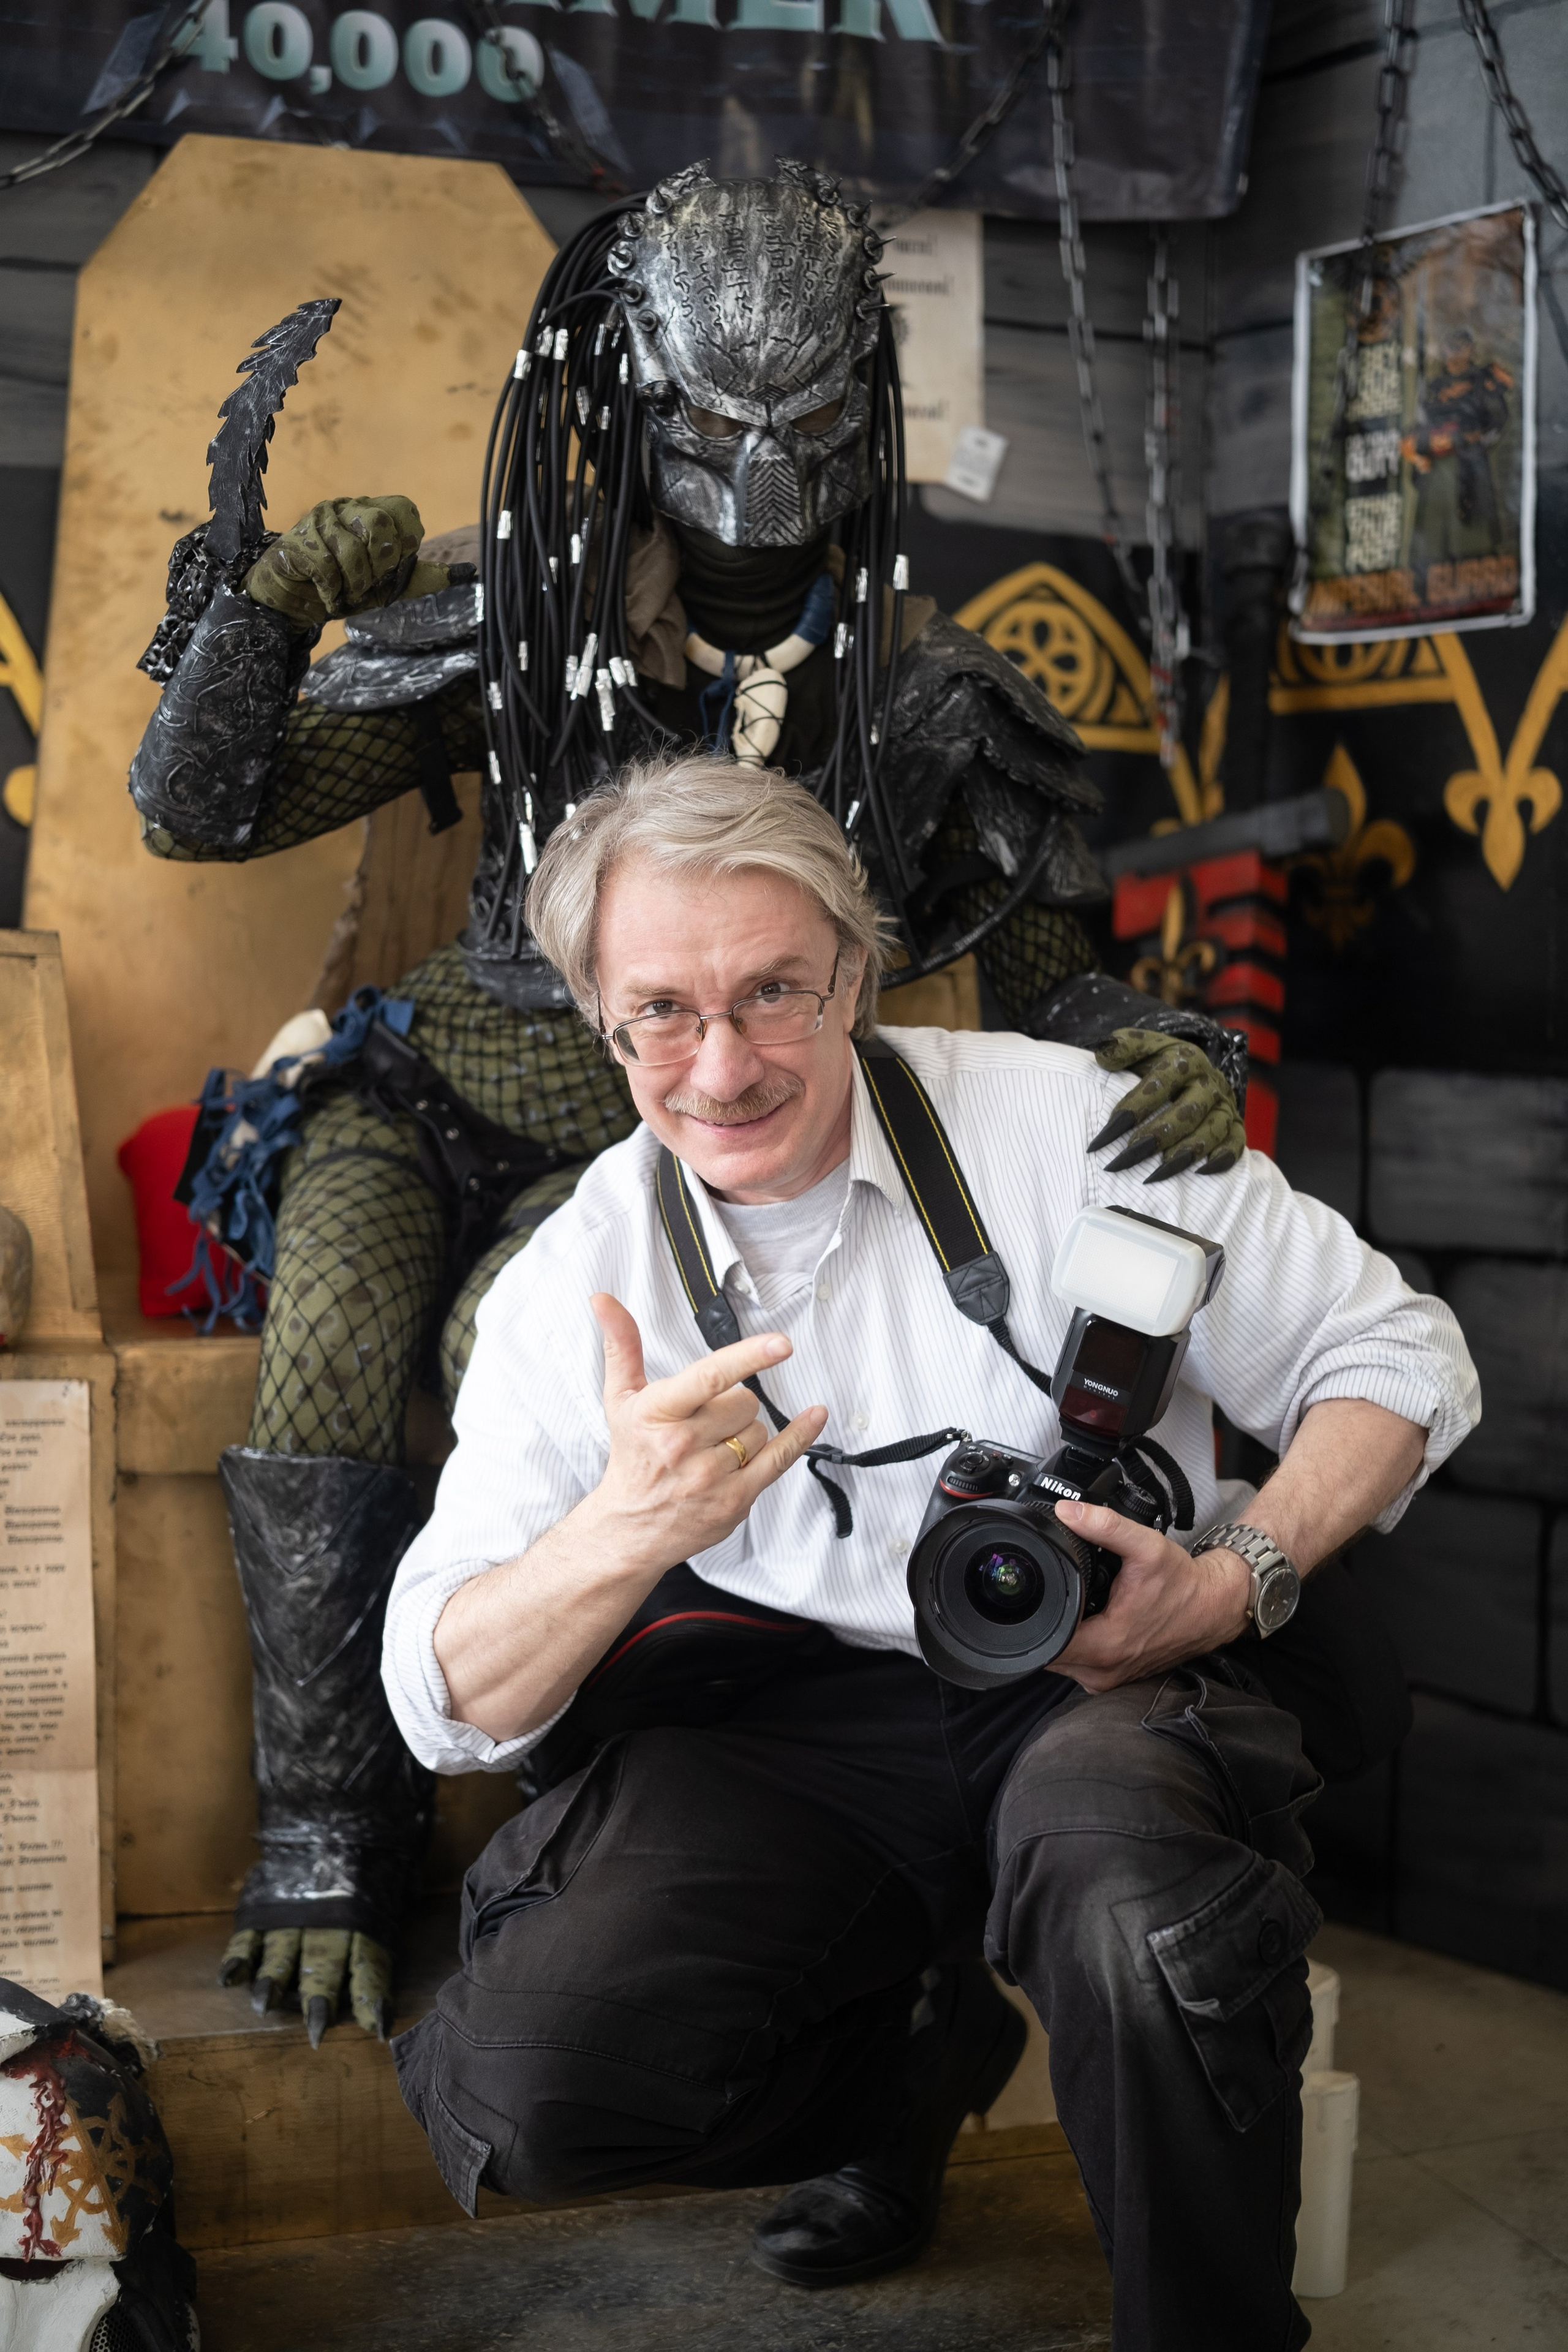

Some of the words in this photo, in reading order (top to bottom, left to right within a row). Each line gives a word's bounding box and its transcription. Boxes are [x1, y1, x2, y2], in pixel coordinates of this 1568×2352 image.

[167, 0, 545, 103] 40,000
[1084, 1378, 1118, 1396] YONGNUO
[1041, 1476, 1081, 1501] Nikon
